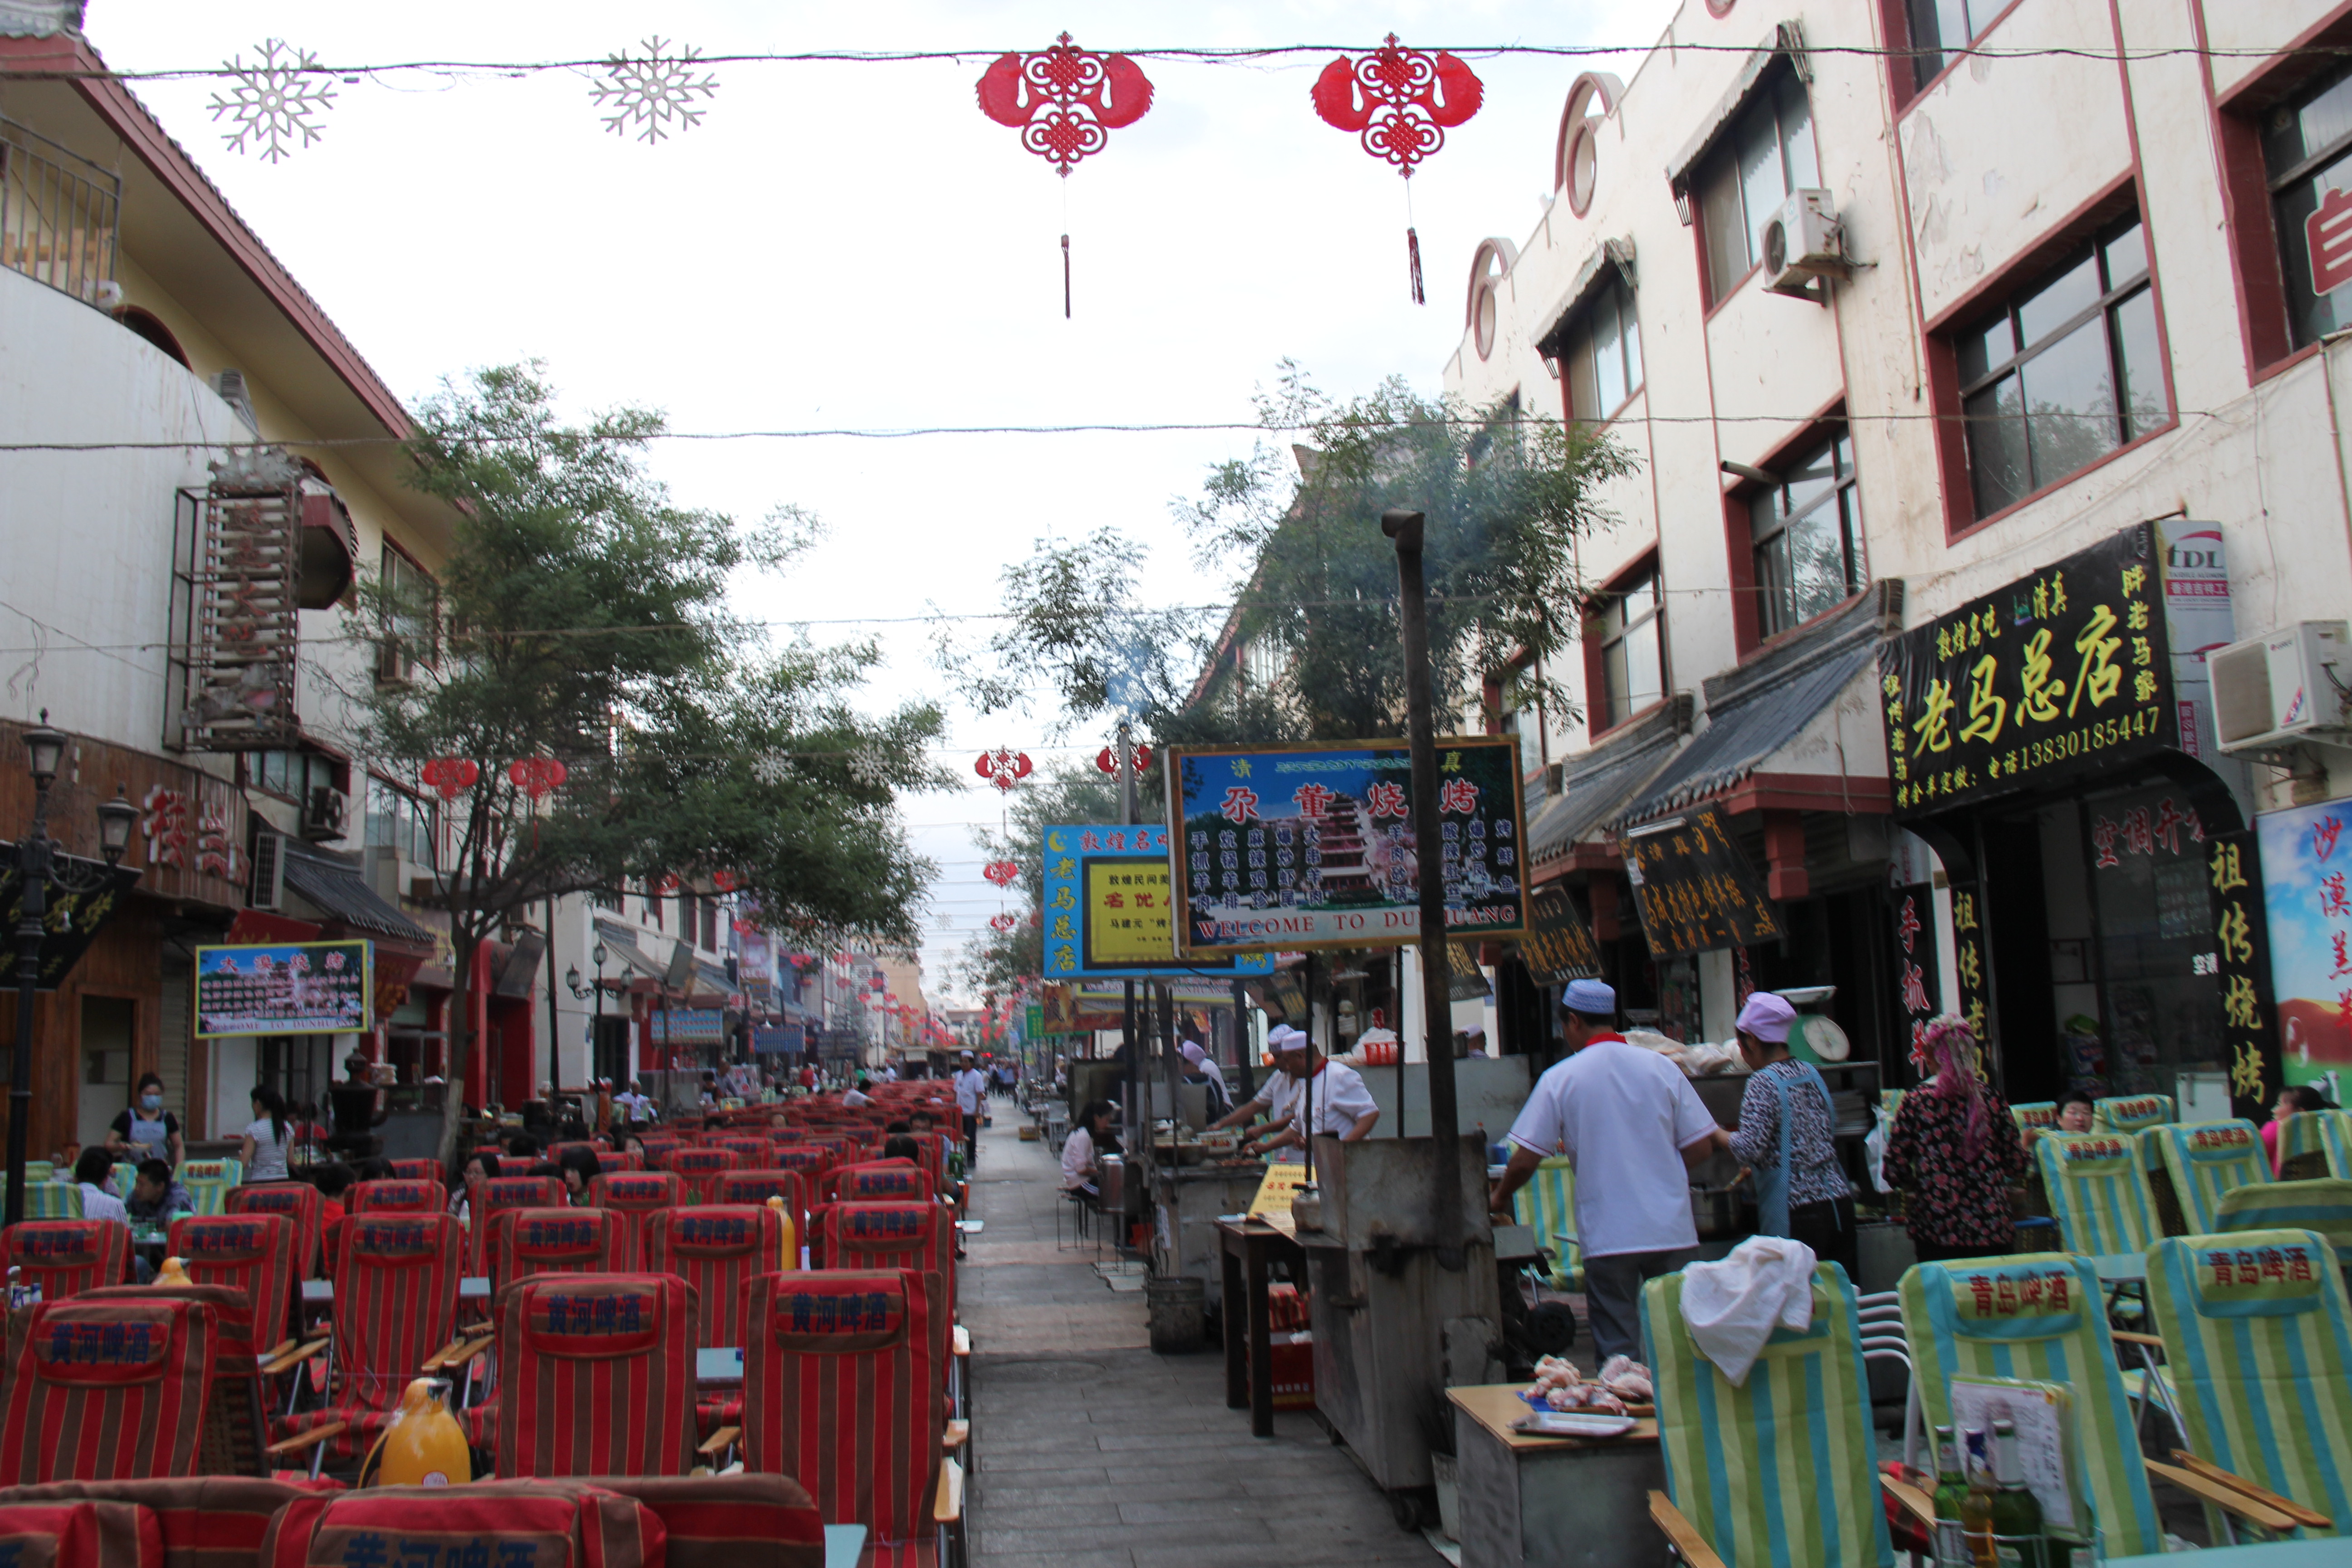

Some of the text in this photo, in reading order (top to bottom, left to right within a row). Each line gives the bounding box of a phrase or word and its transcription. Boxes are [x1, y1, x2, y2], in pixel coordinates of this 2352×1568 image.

[2033, 570, 2068, 620] 清真
[2171, 581, 2228, 595] 香港吉祥工
[1936, 604, 2000, 662] 敦煌名吃
[2122, 564, 2158, 702] 胖老马家
[1911, 604, 2123, 760] 老马总店
[1230, 758, 1252, 778] 清
[1441, 750, 1462, 773] 真
[1191, 830, 1212, 913] 手抓羊肉
[1219, 829, 1240, 911] 炕锅羊排
[1248, 828, 1269, 910] 麻辣鸡珍
[1276, 827, 1297, 908] 爆炒虾尾
[1303, 825, 1324, 907] 大串羊肉
[1388, 824, 1408, 904] 羊肉砂锅
[1441, 822, 1463, 902] 酸辣肚丝
[1468, 820, 1490, 901] 爆炒凤爪
[1495, 819, 1516, 894] 烤鲜鱼
[1049, 855, 1078, 973] 老马总店
[1104, 891, 1171, 908] 名优
[1196, 915, 1314, 939] WELCOME
[1333, 913, 1365, 931] TO
[1384, 905, 1516, 928] DUUANG
[218, 951, 348, 974] 大漠烧烤
[2209, 841, 2266, 1105] 祖传烧烤
[2068, 1138, 2123, 1161] 青岛啤酒
[2195, 1127, 2249, 1149] 青岛啤酒
[23, 1229, 86, 1257] 黄河啤酒
[191, 1224, 255, 1252] 黄河啤酒
[364, 1224, 423, 1251] 黄河啤酒
[528, 1220, 592, 1247] 黄河啤酒
[682, 1217, 745, 1245] 黄河啤酒
[854, 1210, 917, 1236] 黄河啤酒
[2207, 1247, 2311, 1287] 青岛啤酒
[547, 1294, 642, 1336] 黄河啤酒
[791, 1292, 887, 1334] 黄河啤酒
[1969, 1270, 2070, 1317] 青岛啤酒
[50, 1321, 152, 1365] 黄河啤酒
